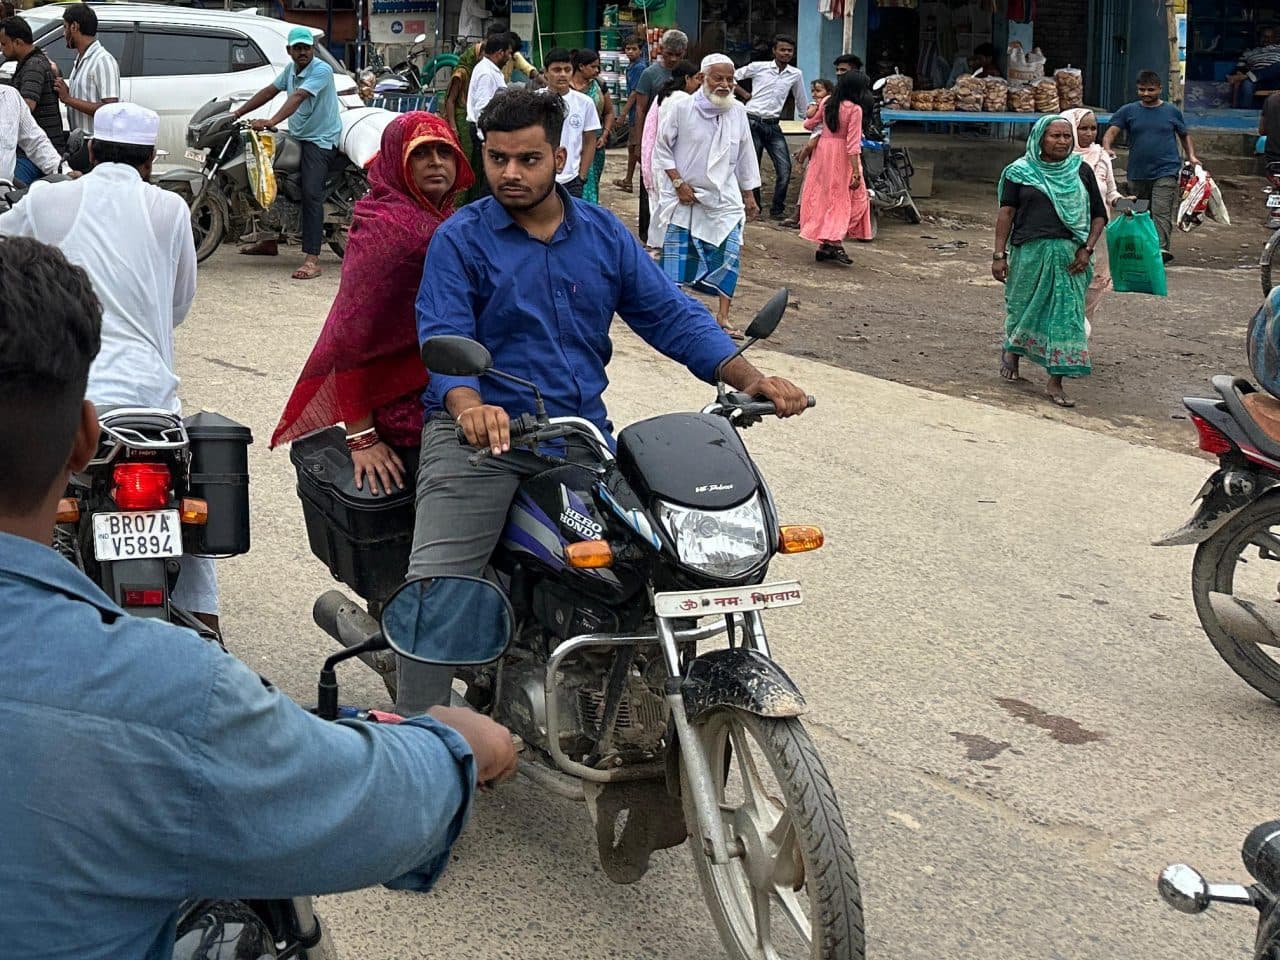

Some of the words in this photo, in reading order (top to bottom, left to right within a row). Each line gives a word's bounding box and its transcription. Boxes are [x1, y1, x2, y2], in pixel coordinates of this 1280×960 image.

[110, 514, 170, 535] BR07A
[559, 514, 603, 541] HONDA
[564, 507, 603, 533] HERO
[112, 534, 173, 557] V5894
[713, 596, 743, 608] नमः
